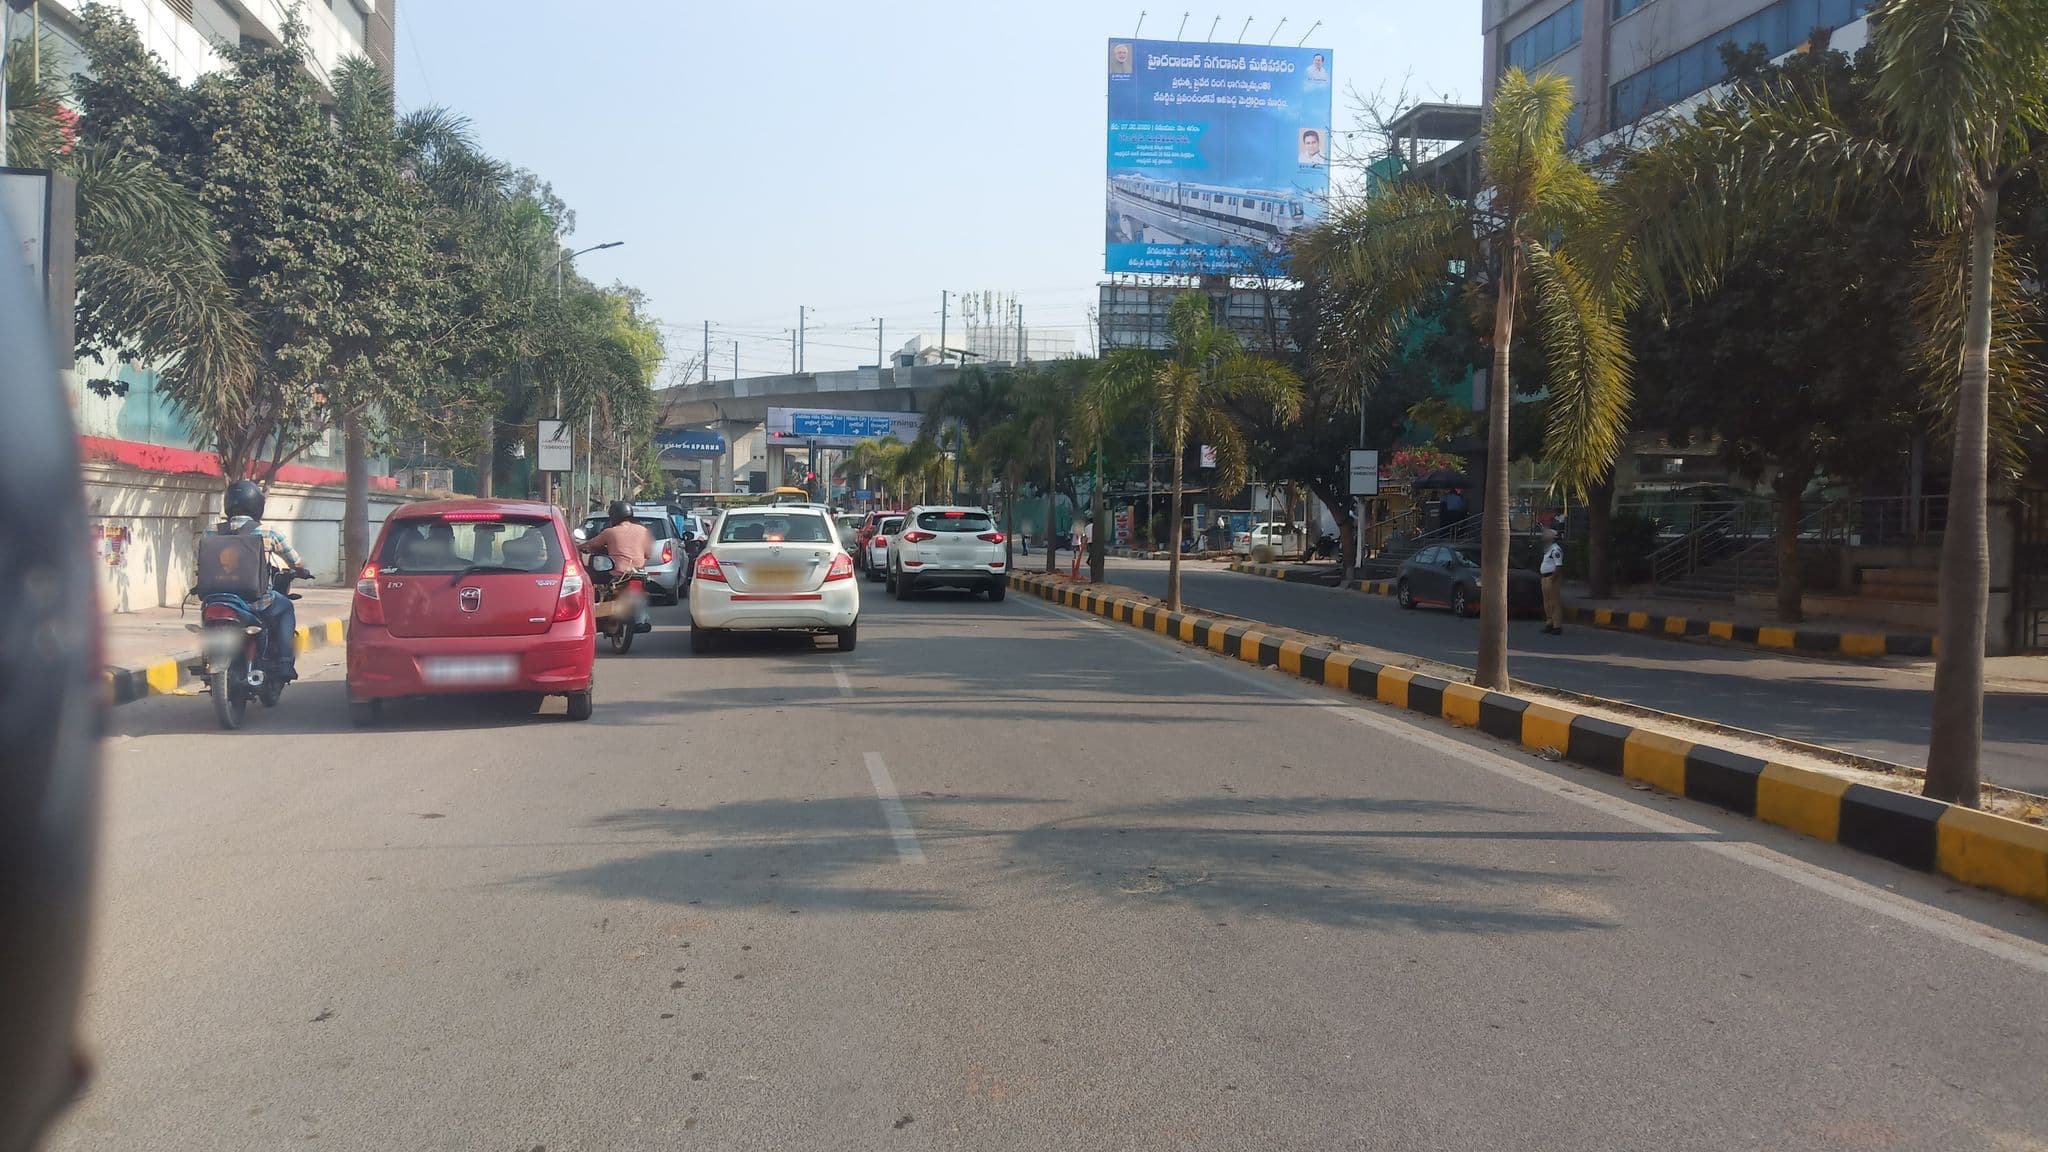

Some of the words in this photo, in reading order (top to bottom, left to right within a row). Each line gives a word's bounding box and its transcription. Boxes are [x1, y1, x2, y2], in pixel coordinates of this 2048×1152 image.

[1147, 54, 1201, 70] హైదరాబాద్
[1204, 55, 1247, 70] నగరానికి
[1249, 57, 1296, 73] మణిహారం
[691, 443, 720, 451] APARNA
